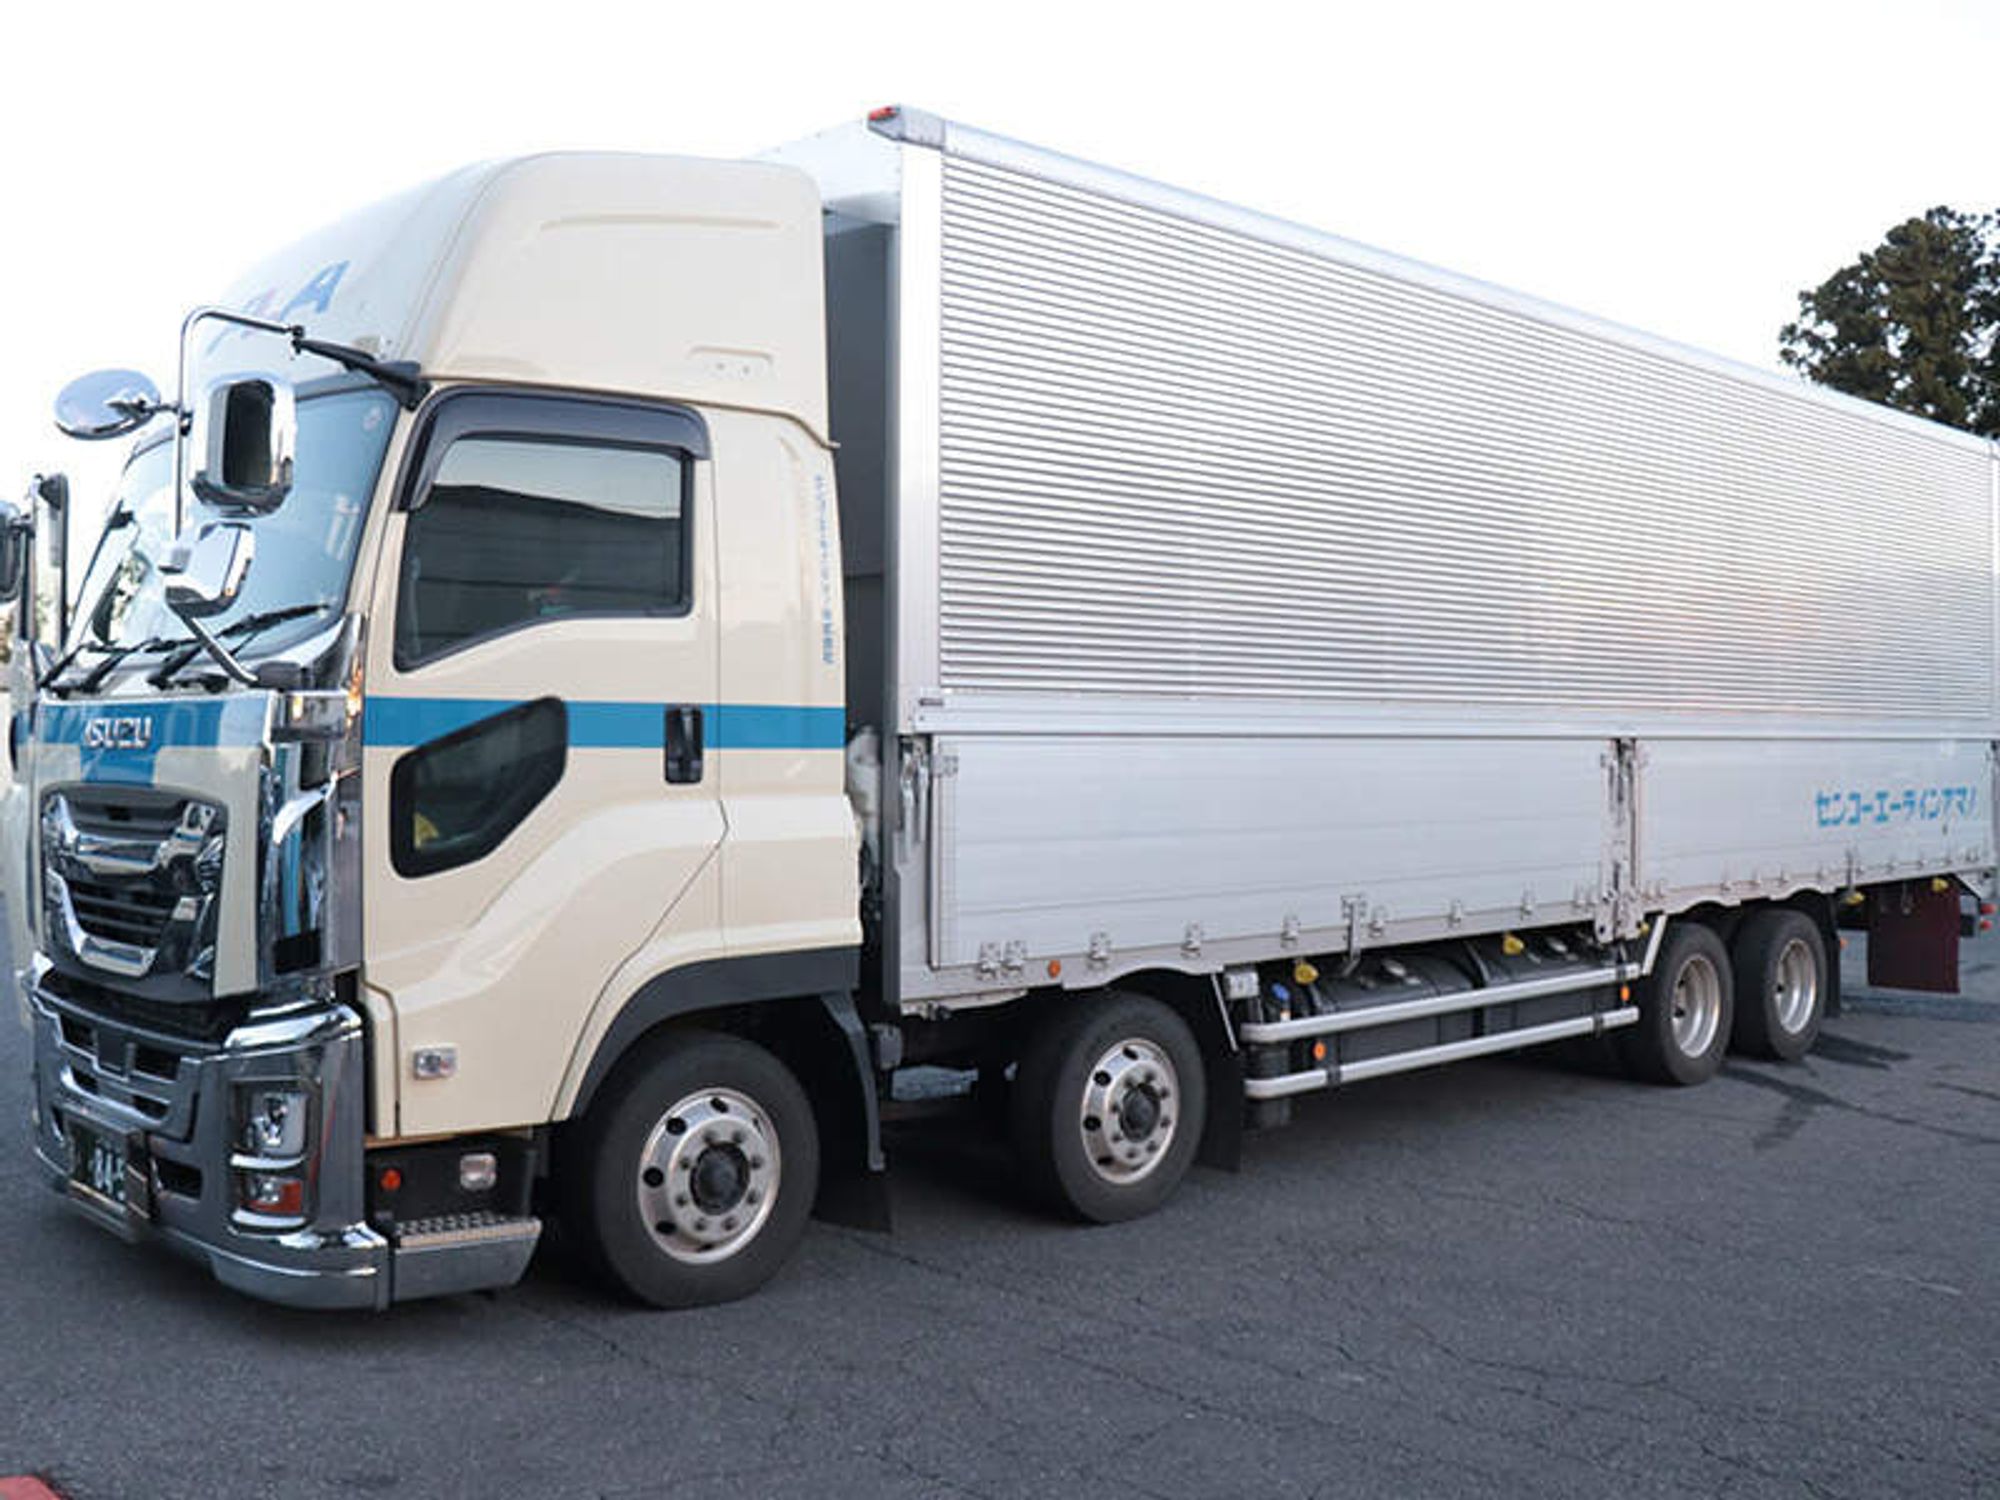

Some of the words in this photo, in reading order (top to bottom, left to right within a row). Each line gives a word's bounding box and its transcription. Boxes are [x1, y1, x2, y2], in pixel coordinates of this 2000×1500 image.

[84, 716, 151, 749] ISUZU
[1816, 785, 1976, 827] センコーエーラインアマノ
